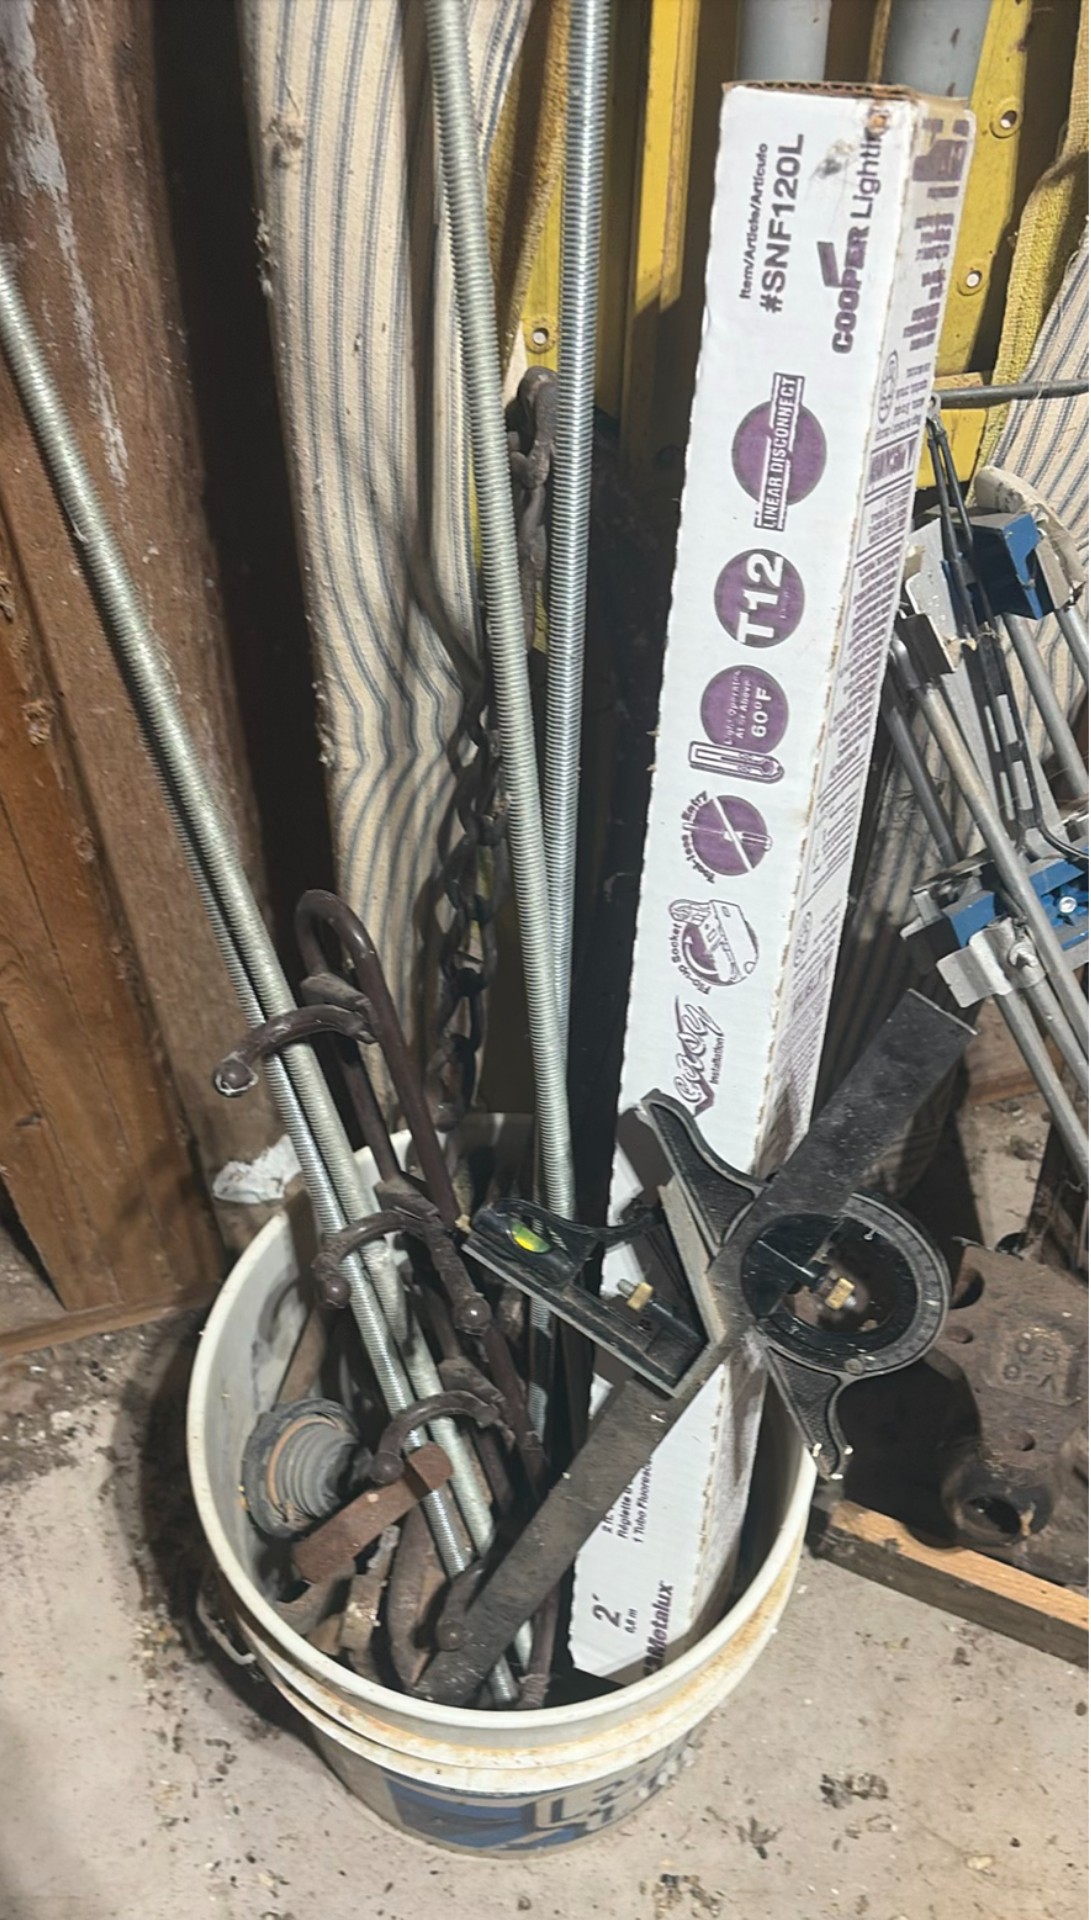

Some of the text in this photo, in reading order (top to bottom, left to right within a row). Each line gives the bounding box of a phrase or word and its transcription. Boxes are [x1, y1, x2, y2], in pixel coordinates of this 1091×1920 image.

[759, 133, 805, 315] #SNF120L
[831, 225, 870, 355] COOPER
[761, 376, 798, 529] LINEAR DISCONNECT
[736, 553, 784, 643] T12
[668, 922, 683, 963] Socket
